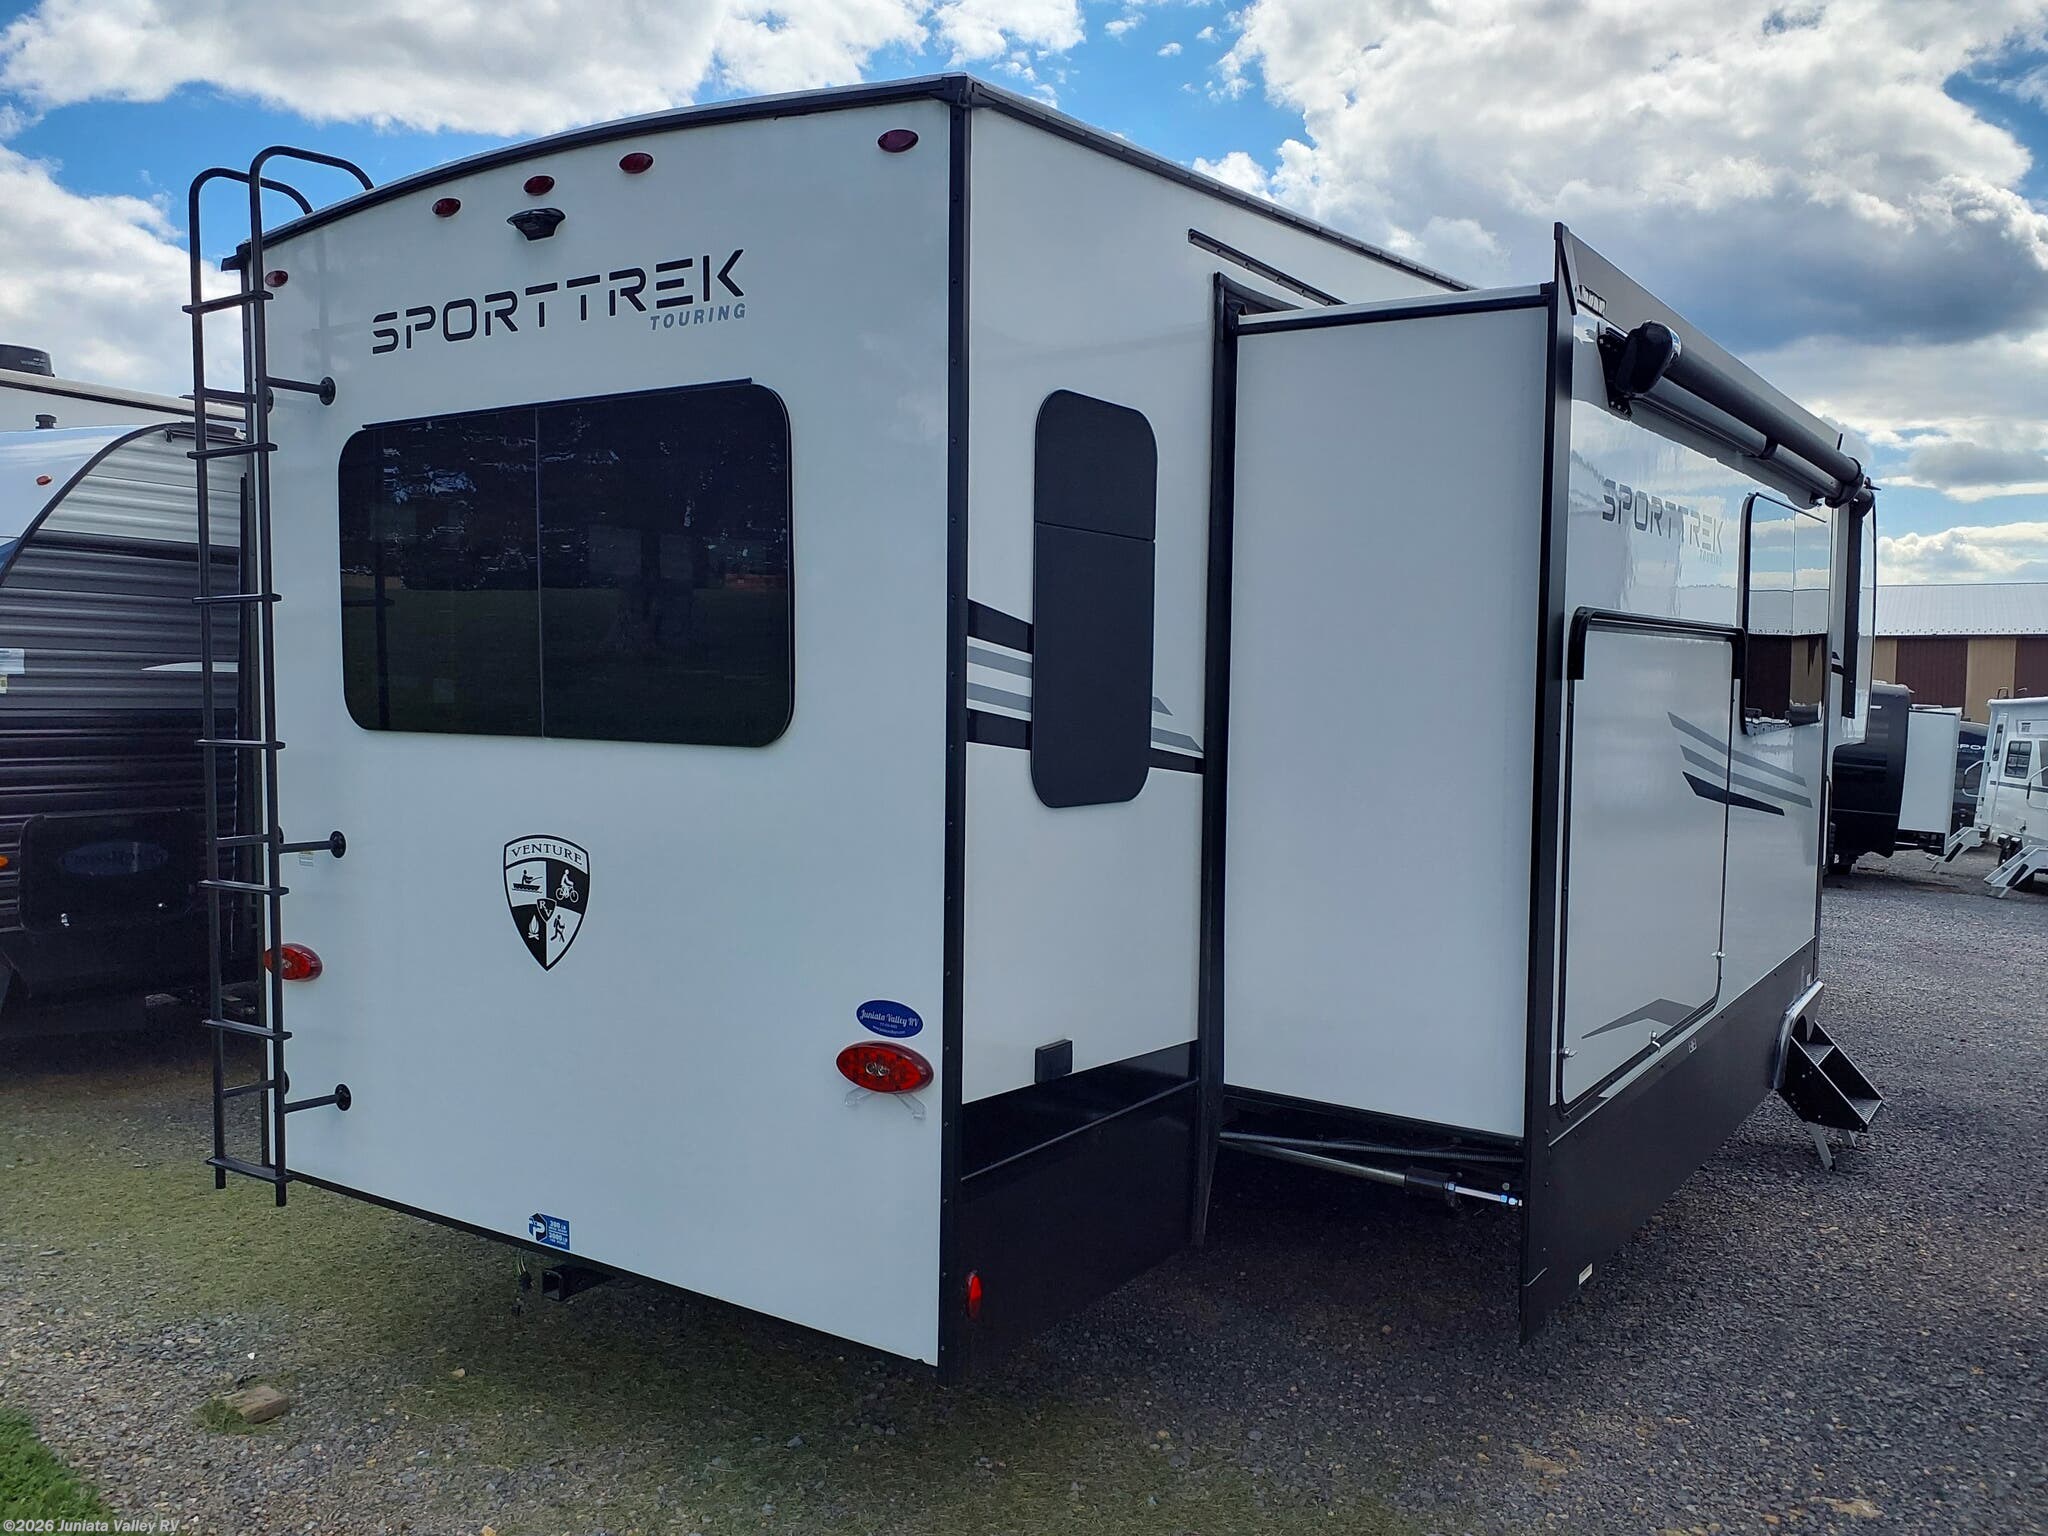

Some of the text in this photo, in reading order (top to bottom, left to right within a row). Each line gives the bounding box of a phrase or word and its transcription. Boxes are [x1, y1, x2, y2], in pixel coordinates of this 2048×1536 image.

[372, 249, 745, 355] SPORTTREK
[650, 303, 747, 331] TOURING
[1602, 478, 1724, 554] SPORTTREK
[511, 843, 583, 866] VENTURE
[859, 1009, 886, 1022] Juniata
[886, 1013, 907, 1028] Valley
[908, 1017, 920, 1027] RV
